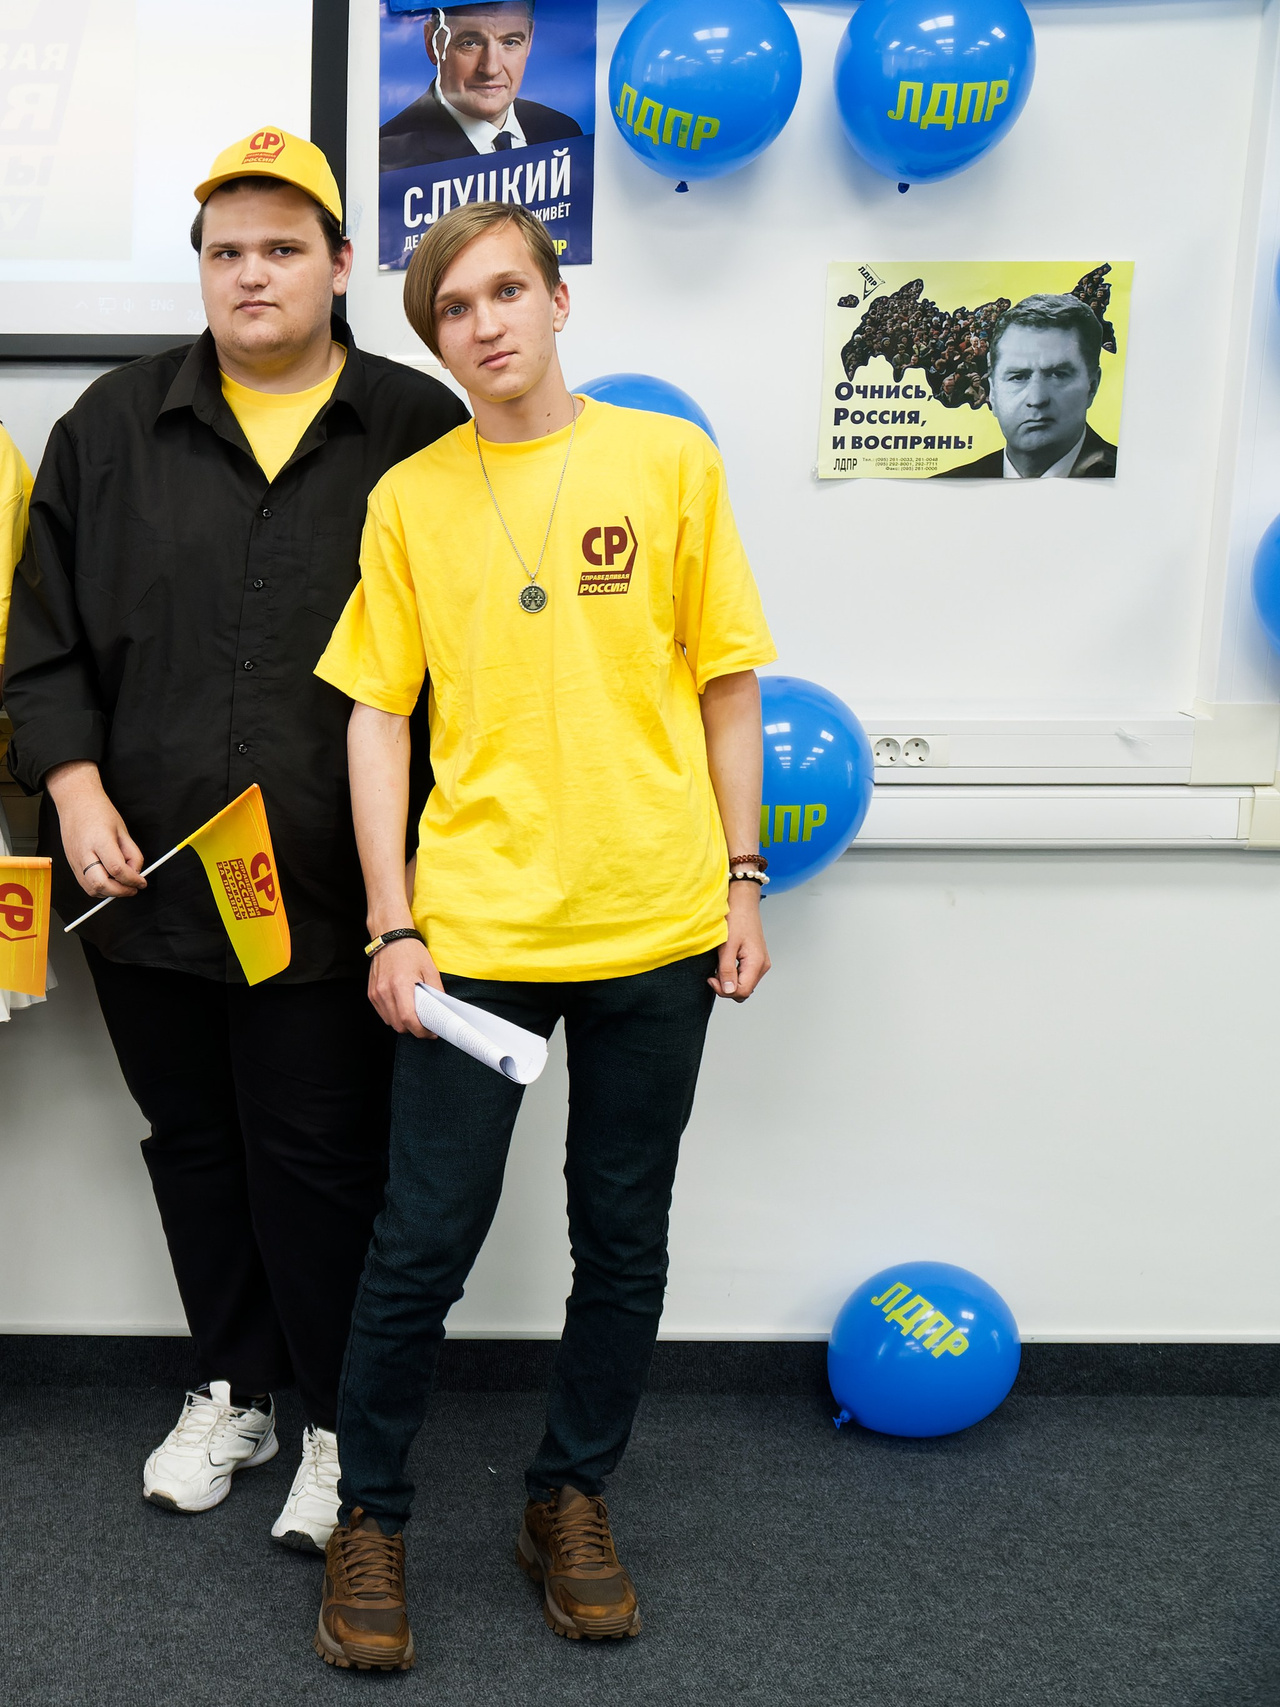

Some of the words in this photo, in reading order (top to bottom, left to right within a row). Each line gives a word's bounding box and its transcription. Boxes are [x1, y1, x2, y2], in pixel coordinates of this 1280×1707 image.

[616, 82, 720, 150] ЛДПР
[887, 79, 1009, 131] ЛДПР
[250, 132, 280, 150] СР
[403, 147, 571, 228] СЛУЦКИЙ
[858, 266, 877, 286] ЛДПР
[833, 458, 858, 472] ЛДПР
[582, 526, 628, 566] СР
[580, 582, 628, 594] РОССИЯ
[760, 803, 828, 847] ПР
[223, 861, 248, 919] ПАТРИОТЫ
[230, 861, 256, 917] РОССИЯ
[250, 851, 275, 902] СР
[871, 1281, 969, 1359] ЛДПР
